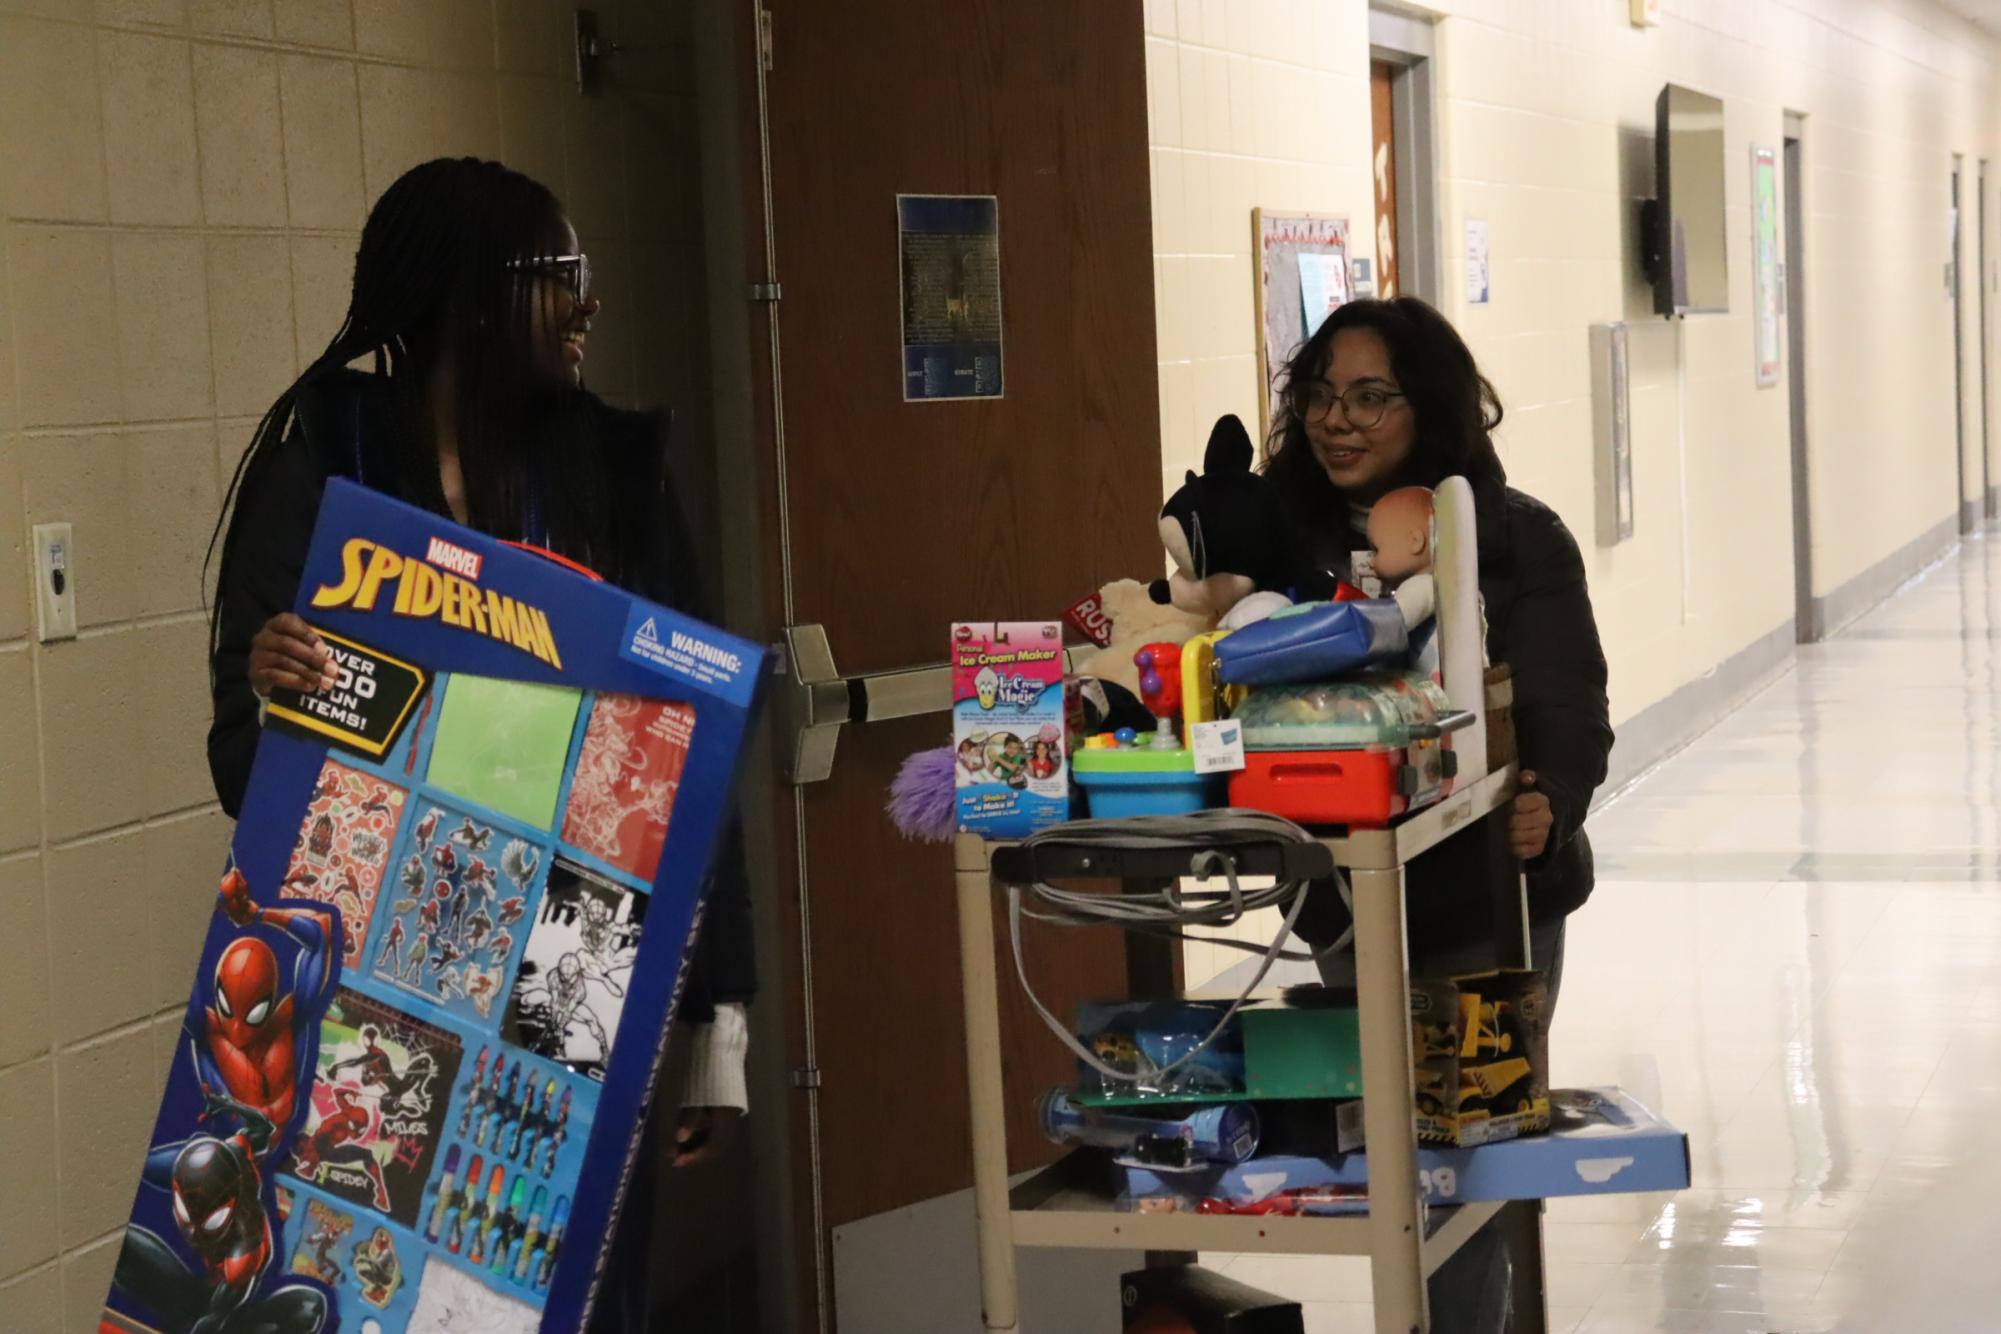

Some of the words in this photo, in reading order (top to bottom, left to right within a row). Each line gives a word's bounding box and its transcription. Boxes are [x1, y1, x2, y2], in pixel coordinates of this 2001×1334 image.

[427, 537, 479, 579] MARVEL
[311, 538, 562, 671] SPIDER-MAN
[633, 635, 664, 656] CHOKING
[665, 646, 694, 666] HAZARD
[671, 631, 742, 673] WARNING:
[960, 656, 976, 666] Ice
[978, 652, 1015, 664] Cream
[1017, 649, 1056, 661] Maker
[335, 668, 377, 699] 00
[999, 688, 1036, 704] Magic
[1000, 676, 1012, 688] Ice
[1013, 677, 1043, 690] Cream
[316, 687, 358, 711] FUN
[300, 695, 368, 731] ITEMS!
[384, 1121, 428, 1136] MILES
[329, 1168, 369, 1188] SPIDEY
